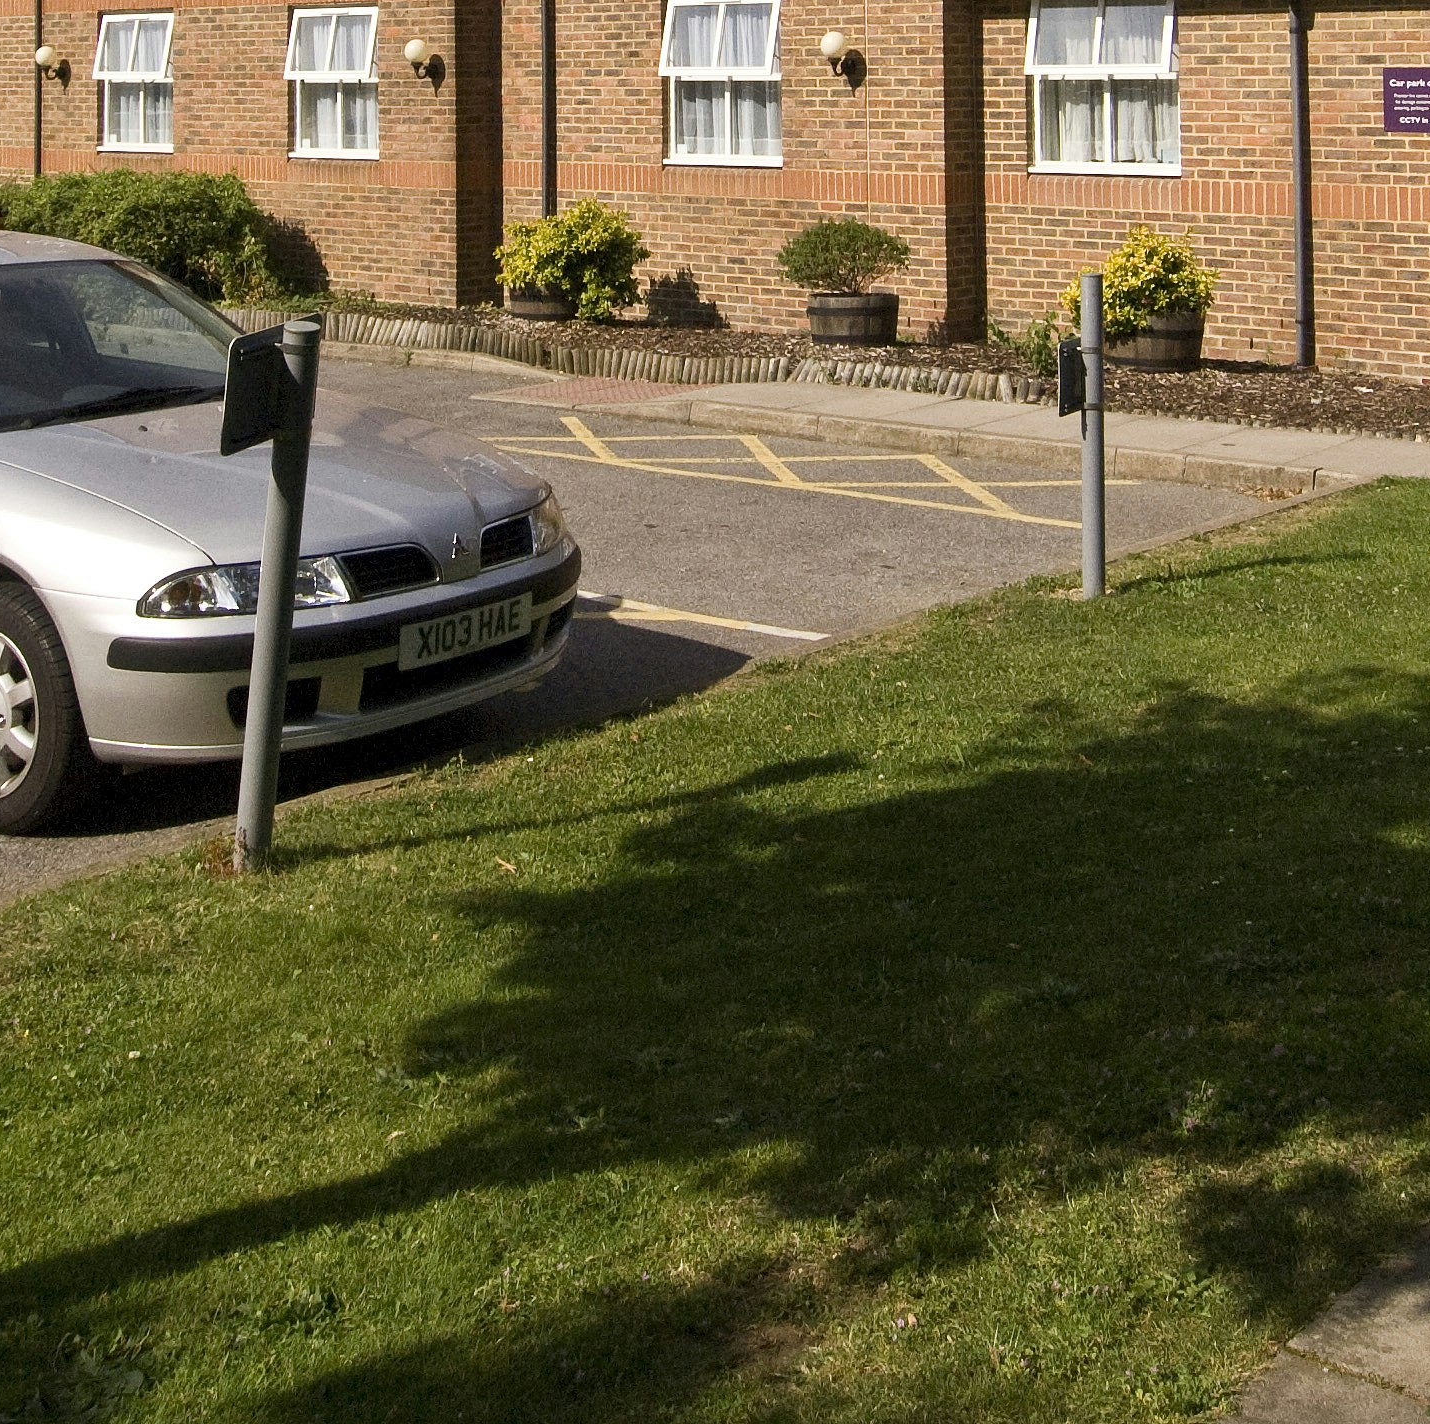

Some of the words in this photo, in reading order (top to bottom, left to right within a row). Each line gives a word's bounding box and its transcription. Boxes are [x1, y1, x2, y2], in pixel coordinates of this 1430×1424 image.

[1389, 79, 1405, 88] Car
[1406, 79, 1426, 89] park
[1399, 116, 1420, 125] CCTV
[1421, 117, 1429, 125] in
[417, 614, 472, 659] X103
[478, 599, 521, 643] HAE
